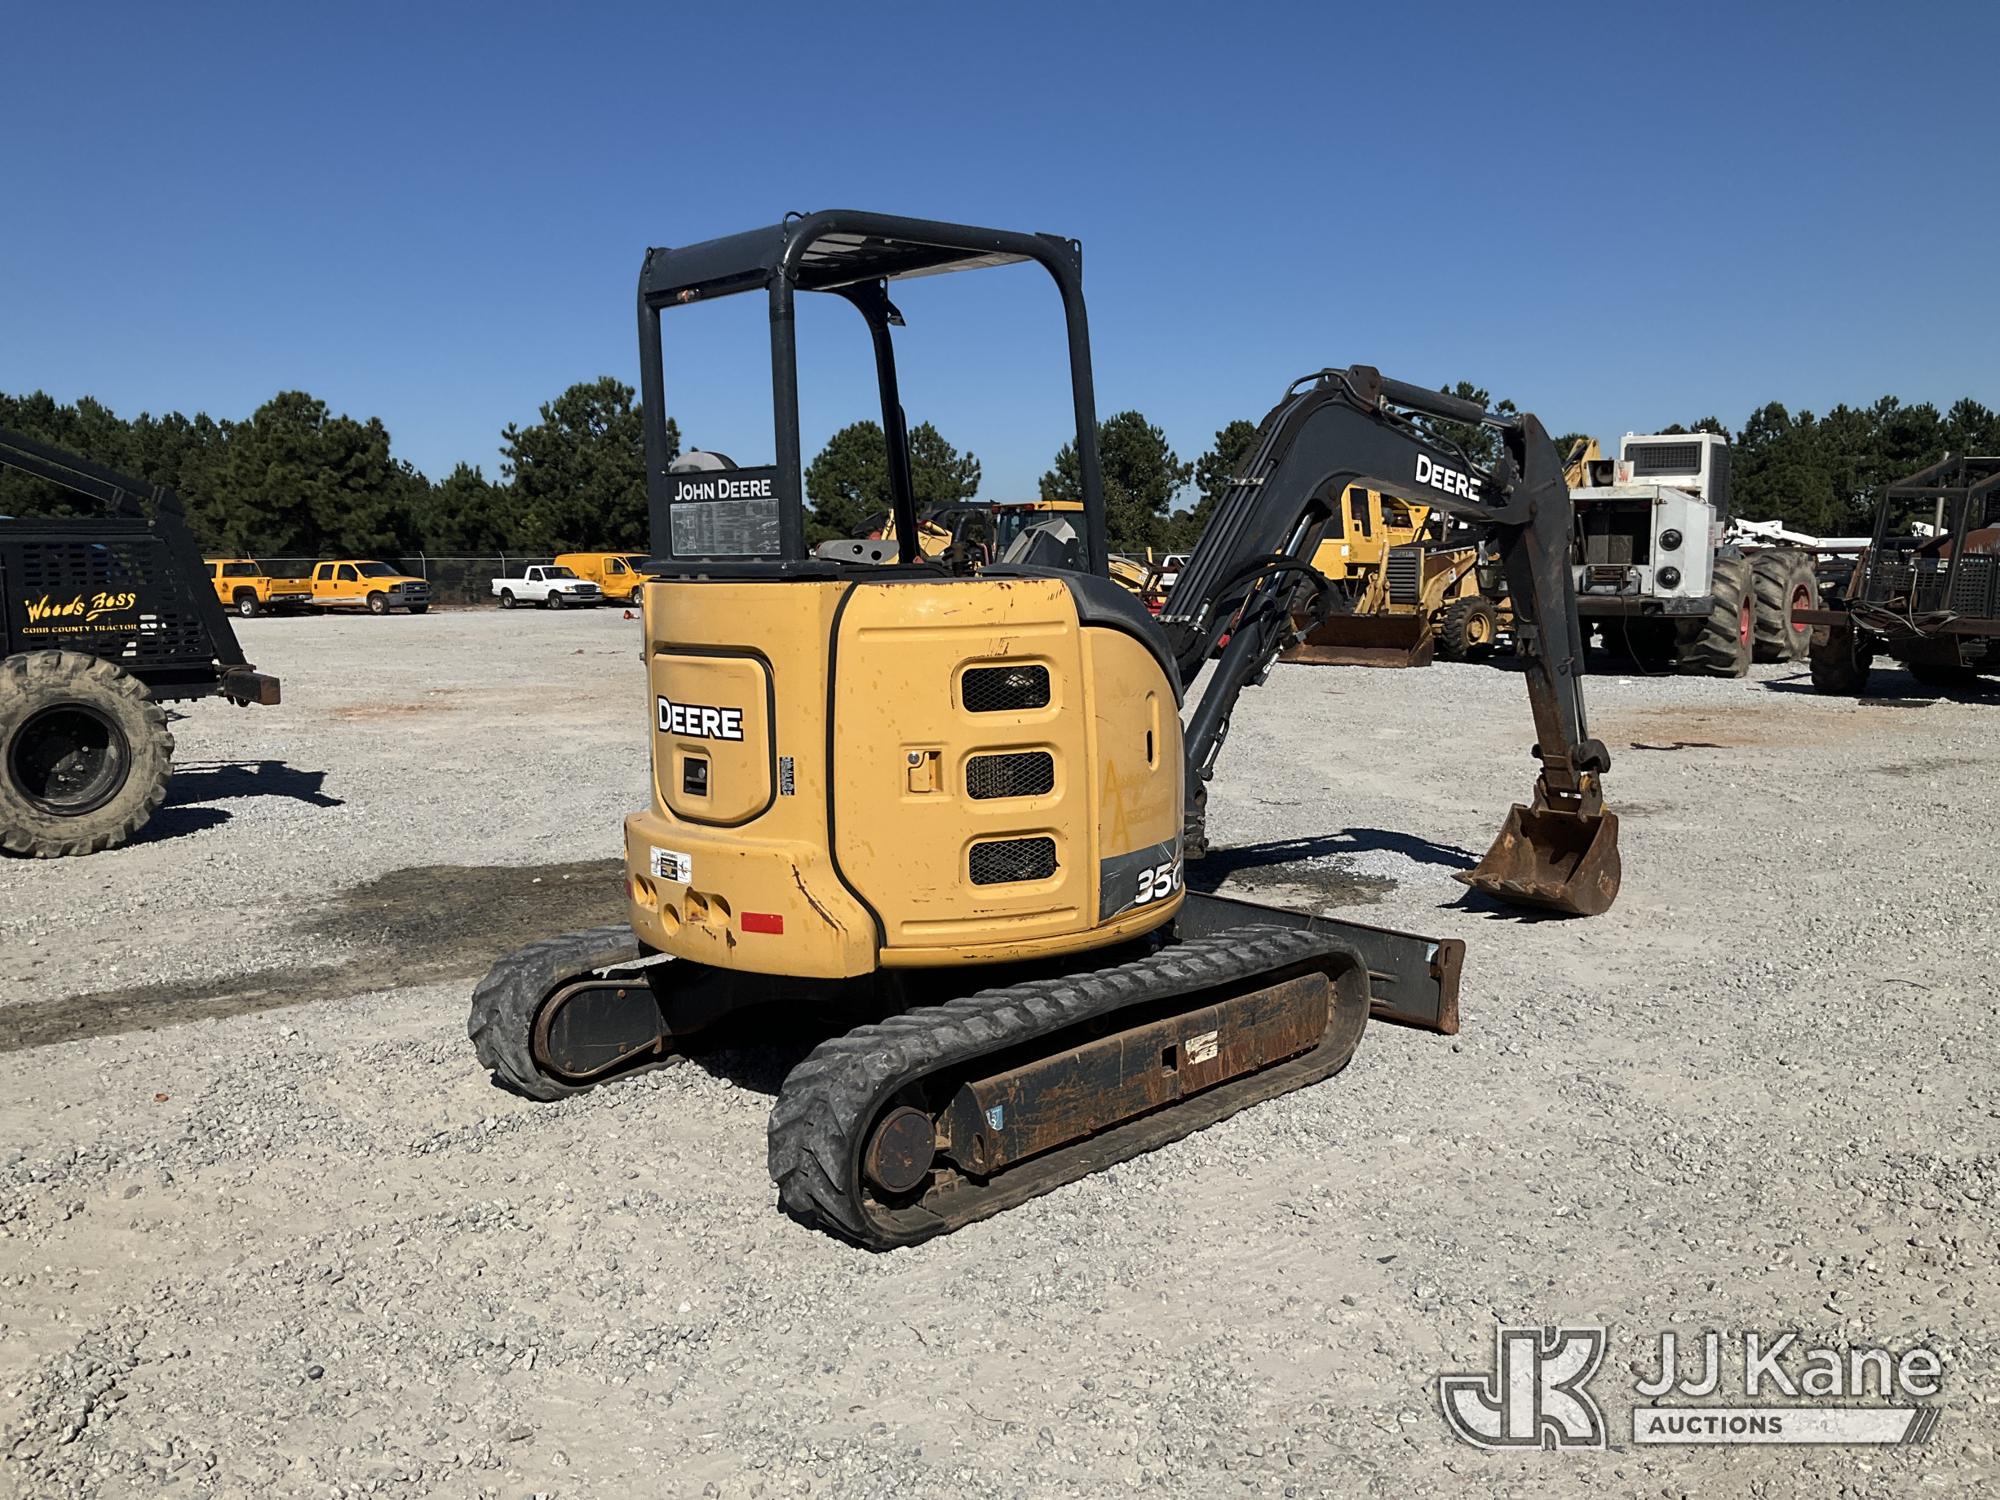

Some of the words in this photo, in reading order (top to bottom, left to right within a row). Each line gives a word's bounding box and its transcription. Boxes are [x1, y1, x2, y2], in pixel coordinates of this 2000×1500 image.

[674, 481, 715, 501] JOHN
[717, 479, 772, 499] DEERE
[1415, 453, 1482, 502] DEERE
[24, 594, 85, 623] Woods
[86, 592, 136, 619] Boss
[22, 626, 49, 634] COBB
[51, 625, 91, 633] COUNTY
[93, 623, 138, 632] TRACTOR
[657, 696, 743, 741] DEERE
